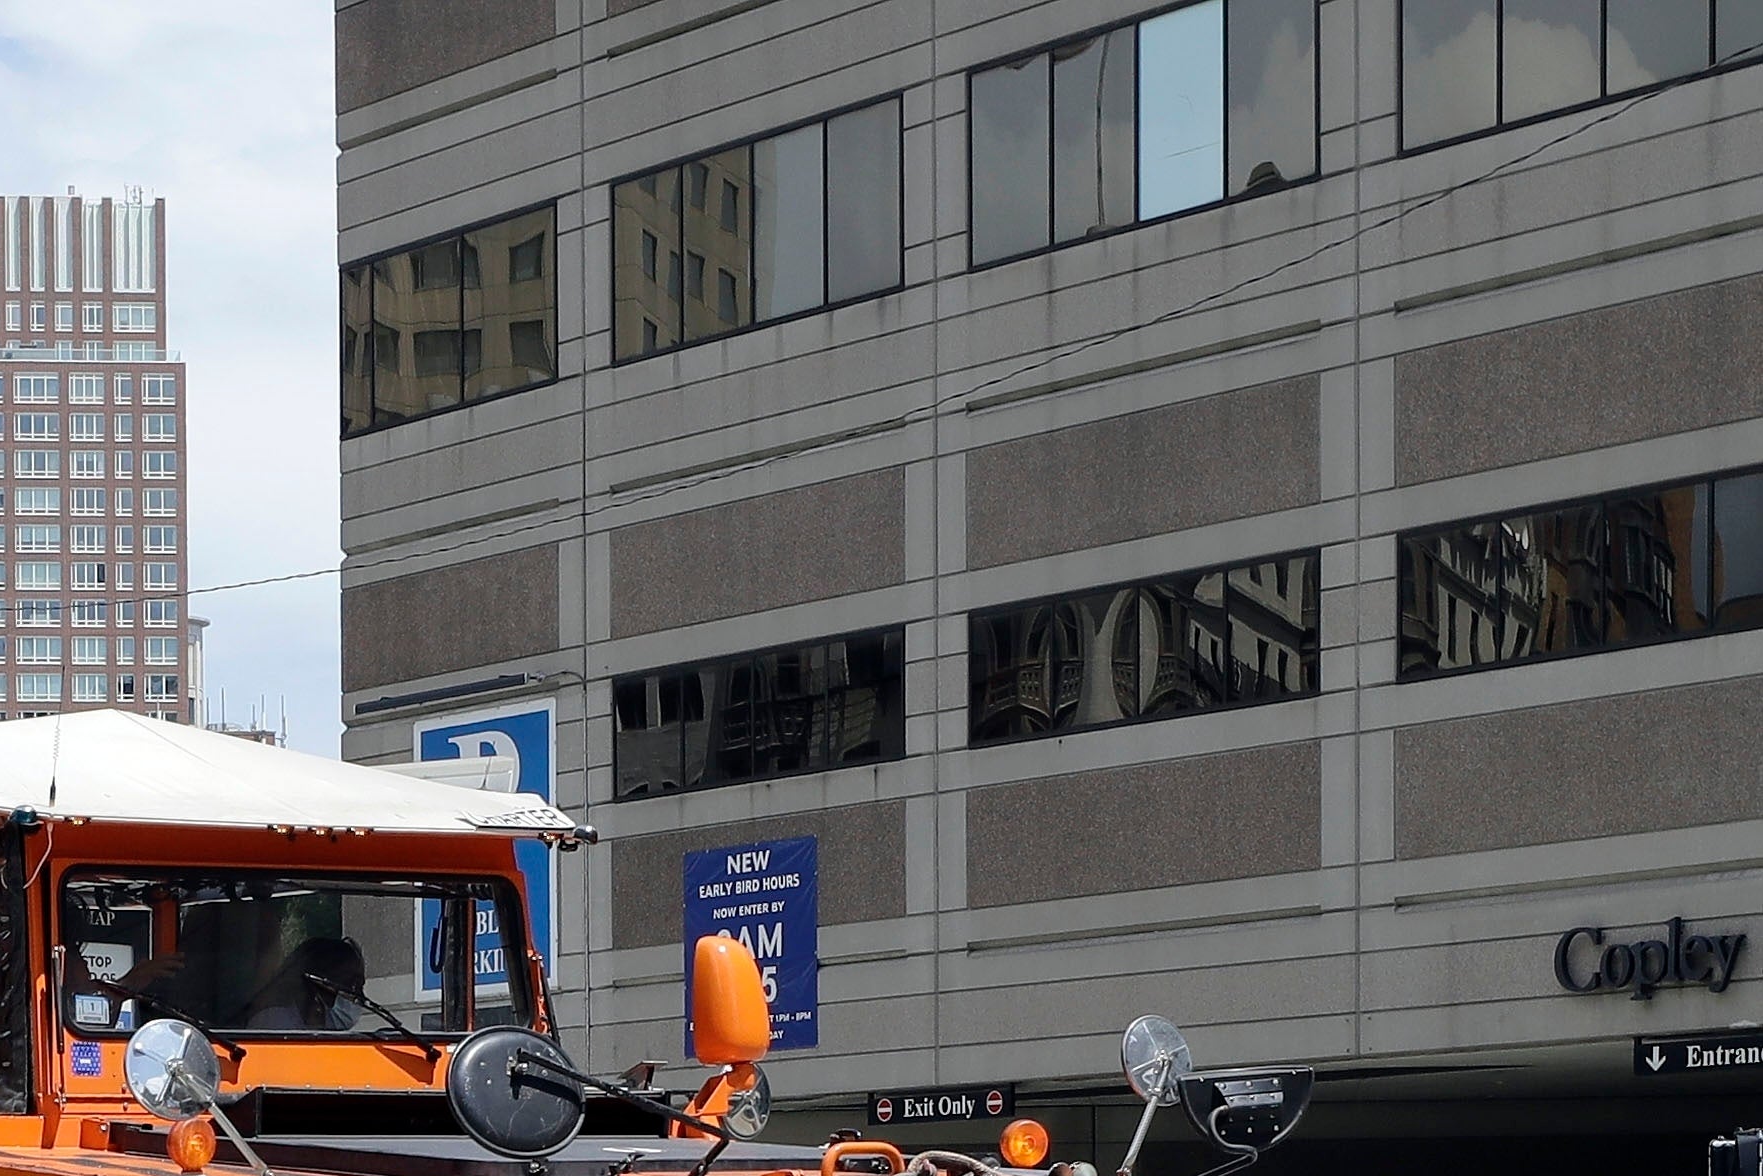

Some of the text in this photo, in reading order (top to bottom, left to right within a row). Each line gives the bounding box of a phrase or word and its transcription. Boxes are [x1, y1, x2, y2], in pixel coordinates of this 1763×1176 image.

[727, 850, 770, 875] NEW
[699, 873, 800, 899] EARLY BIRD HOURS
[713, 901, 785, 920] NOW ENTER BY
[717, 922, 782, 960] AM
[1554, 917, 1747, 1000] Copley
[1686, 1045, 1763, 1067] Entran
[903, 1095, 975, 1119] Exit Only
